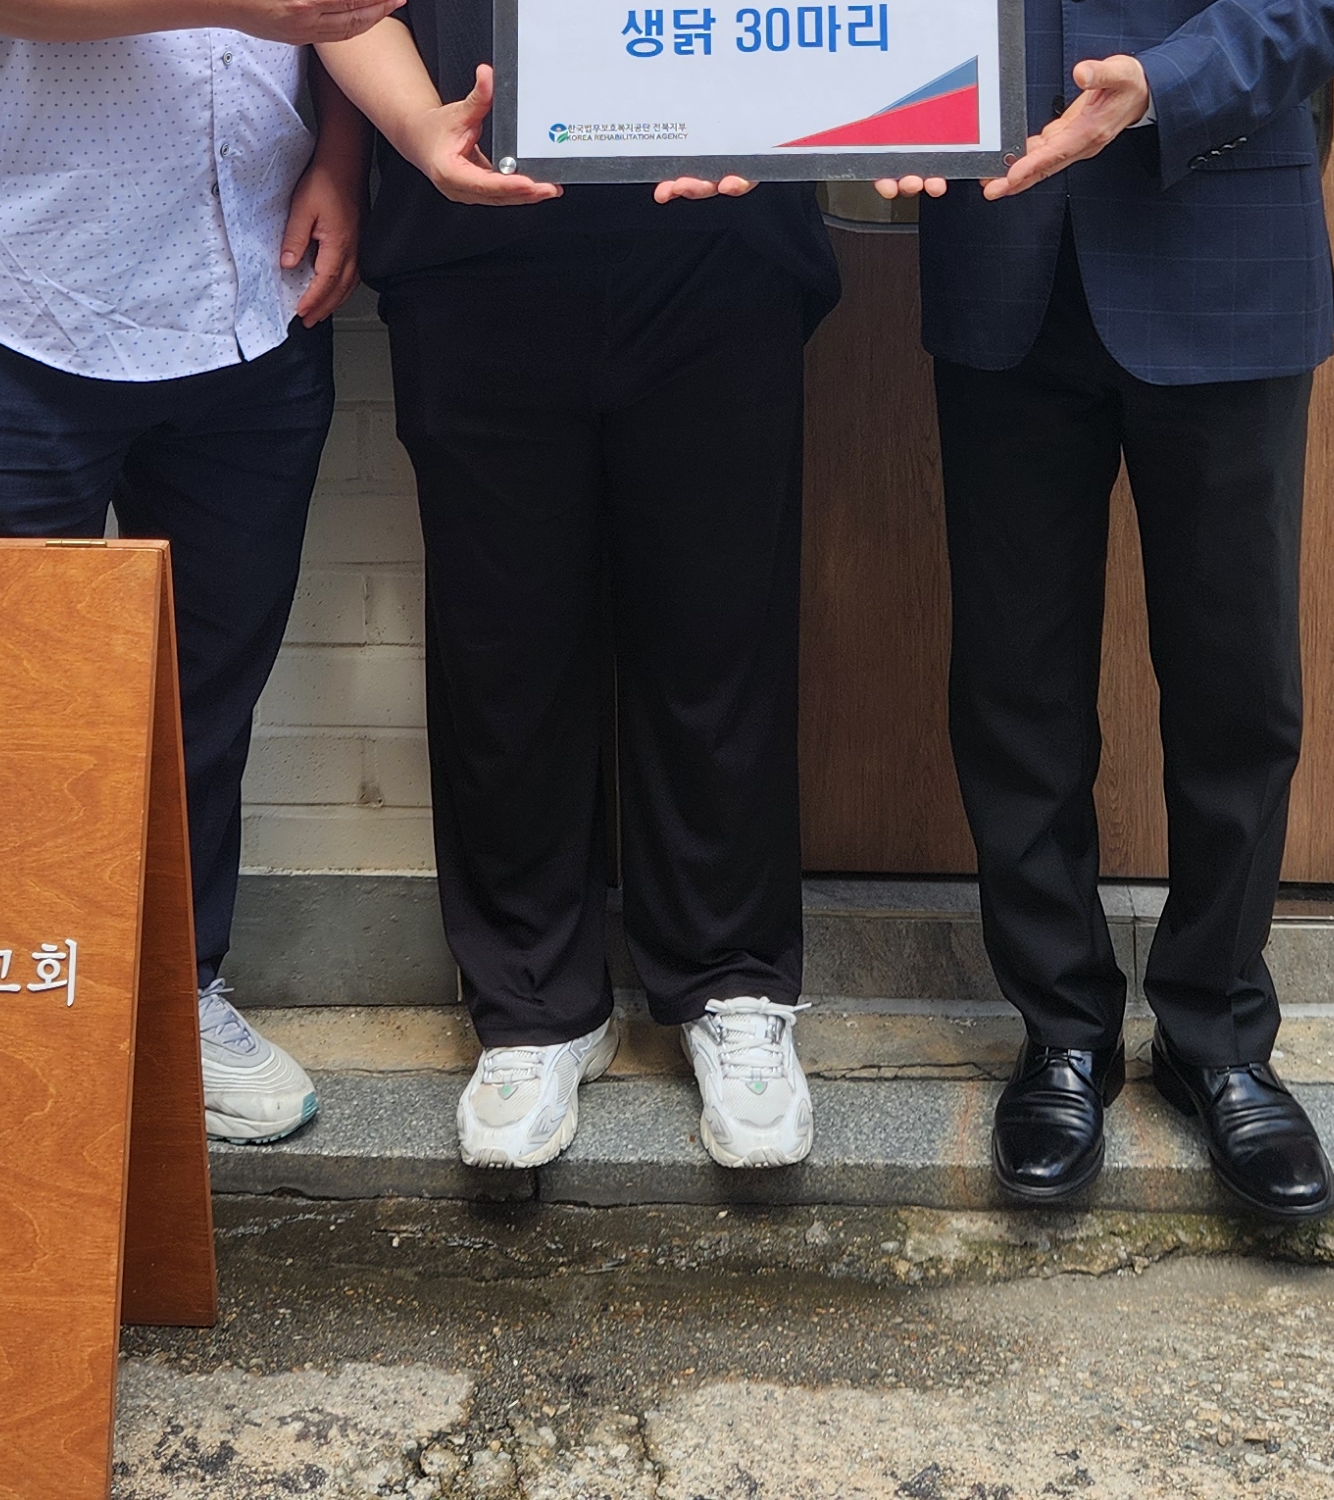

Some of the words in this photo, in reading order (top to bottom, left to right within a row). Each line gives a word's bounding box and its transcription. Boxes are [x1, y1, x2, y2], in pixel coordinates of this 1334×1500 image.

[621, 8, 717, 58] 생닭
[735, 3, 889, 53] 30마리
[653, 122, 686, 132] 전북지부
[566, 133, 592, 141] KOREA
[594, 132, 655, 141] REHABILITATION
[656, 132, 688, 140] AGENCY
